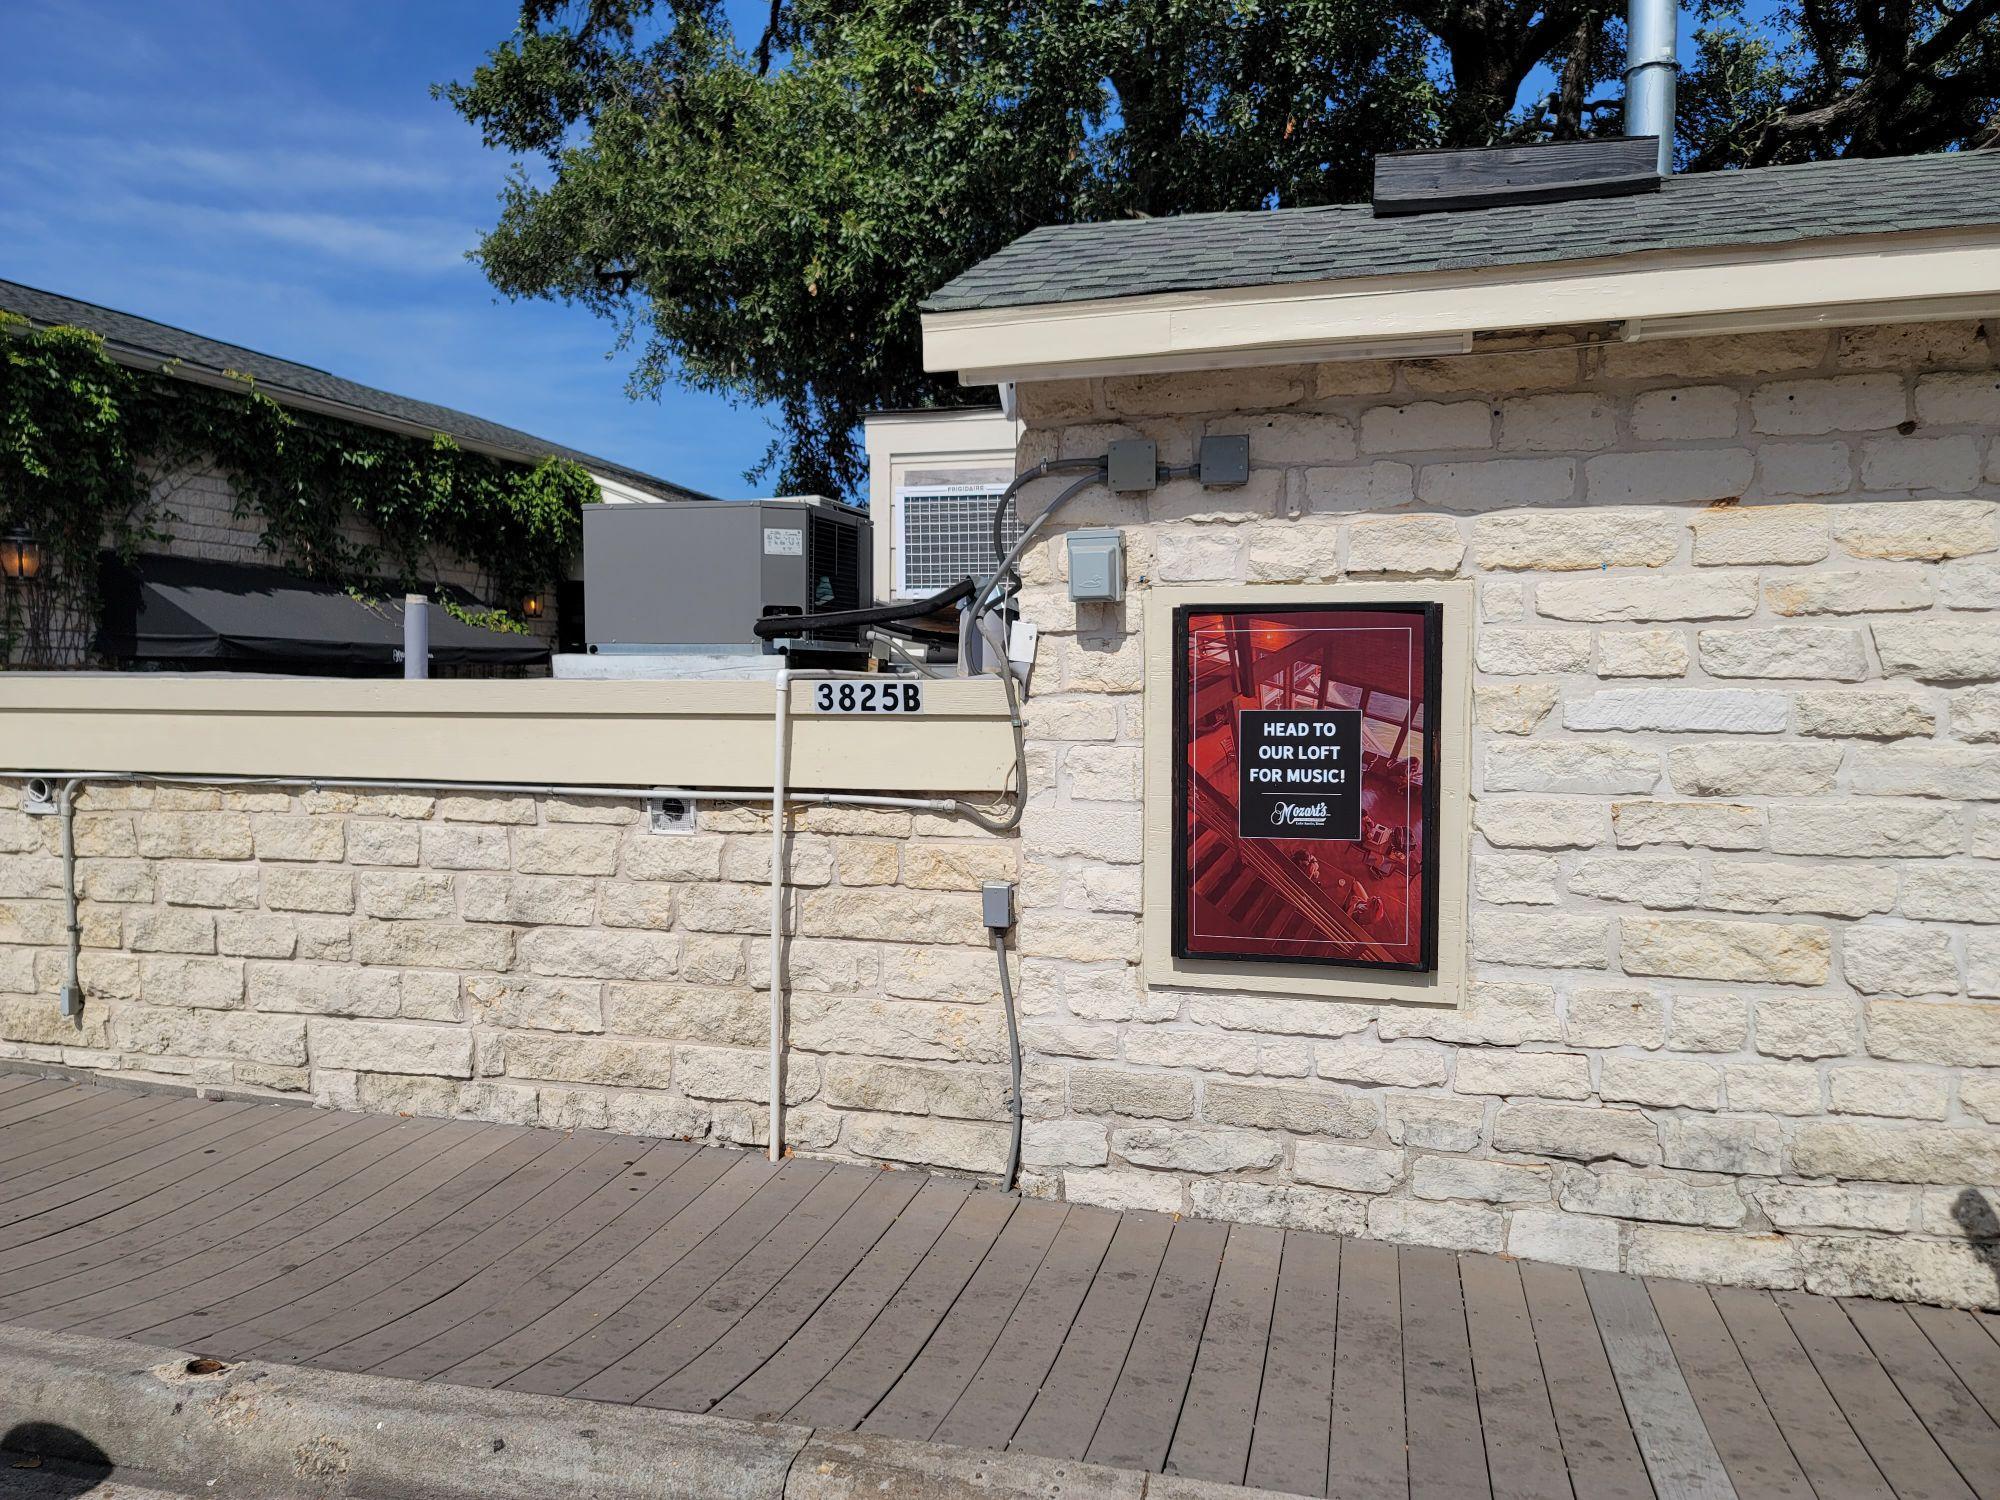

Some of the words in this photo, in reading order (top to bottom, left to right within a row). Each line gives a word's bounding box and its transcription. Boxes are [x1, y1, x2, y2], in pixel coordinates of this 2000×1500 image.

[817, 683, 921, 712] 3825B
[1263, 722, 1310, 737] HEAD
[1312, 722, 1337, 737] TO
[1258, 745, 1294, 760] OUR
[1298, 745, 1341, 760] LOFT
[1249, 768, 1283, 782] FOR
[1286, 768, 1346, 783] MUSIC!
[1270, 801, 1328, 826] Mozart's
